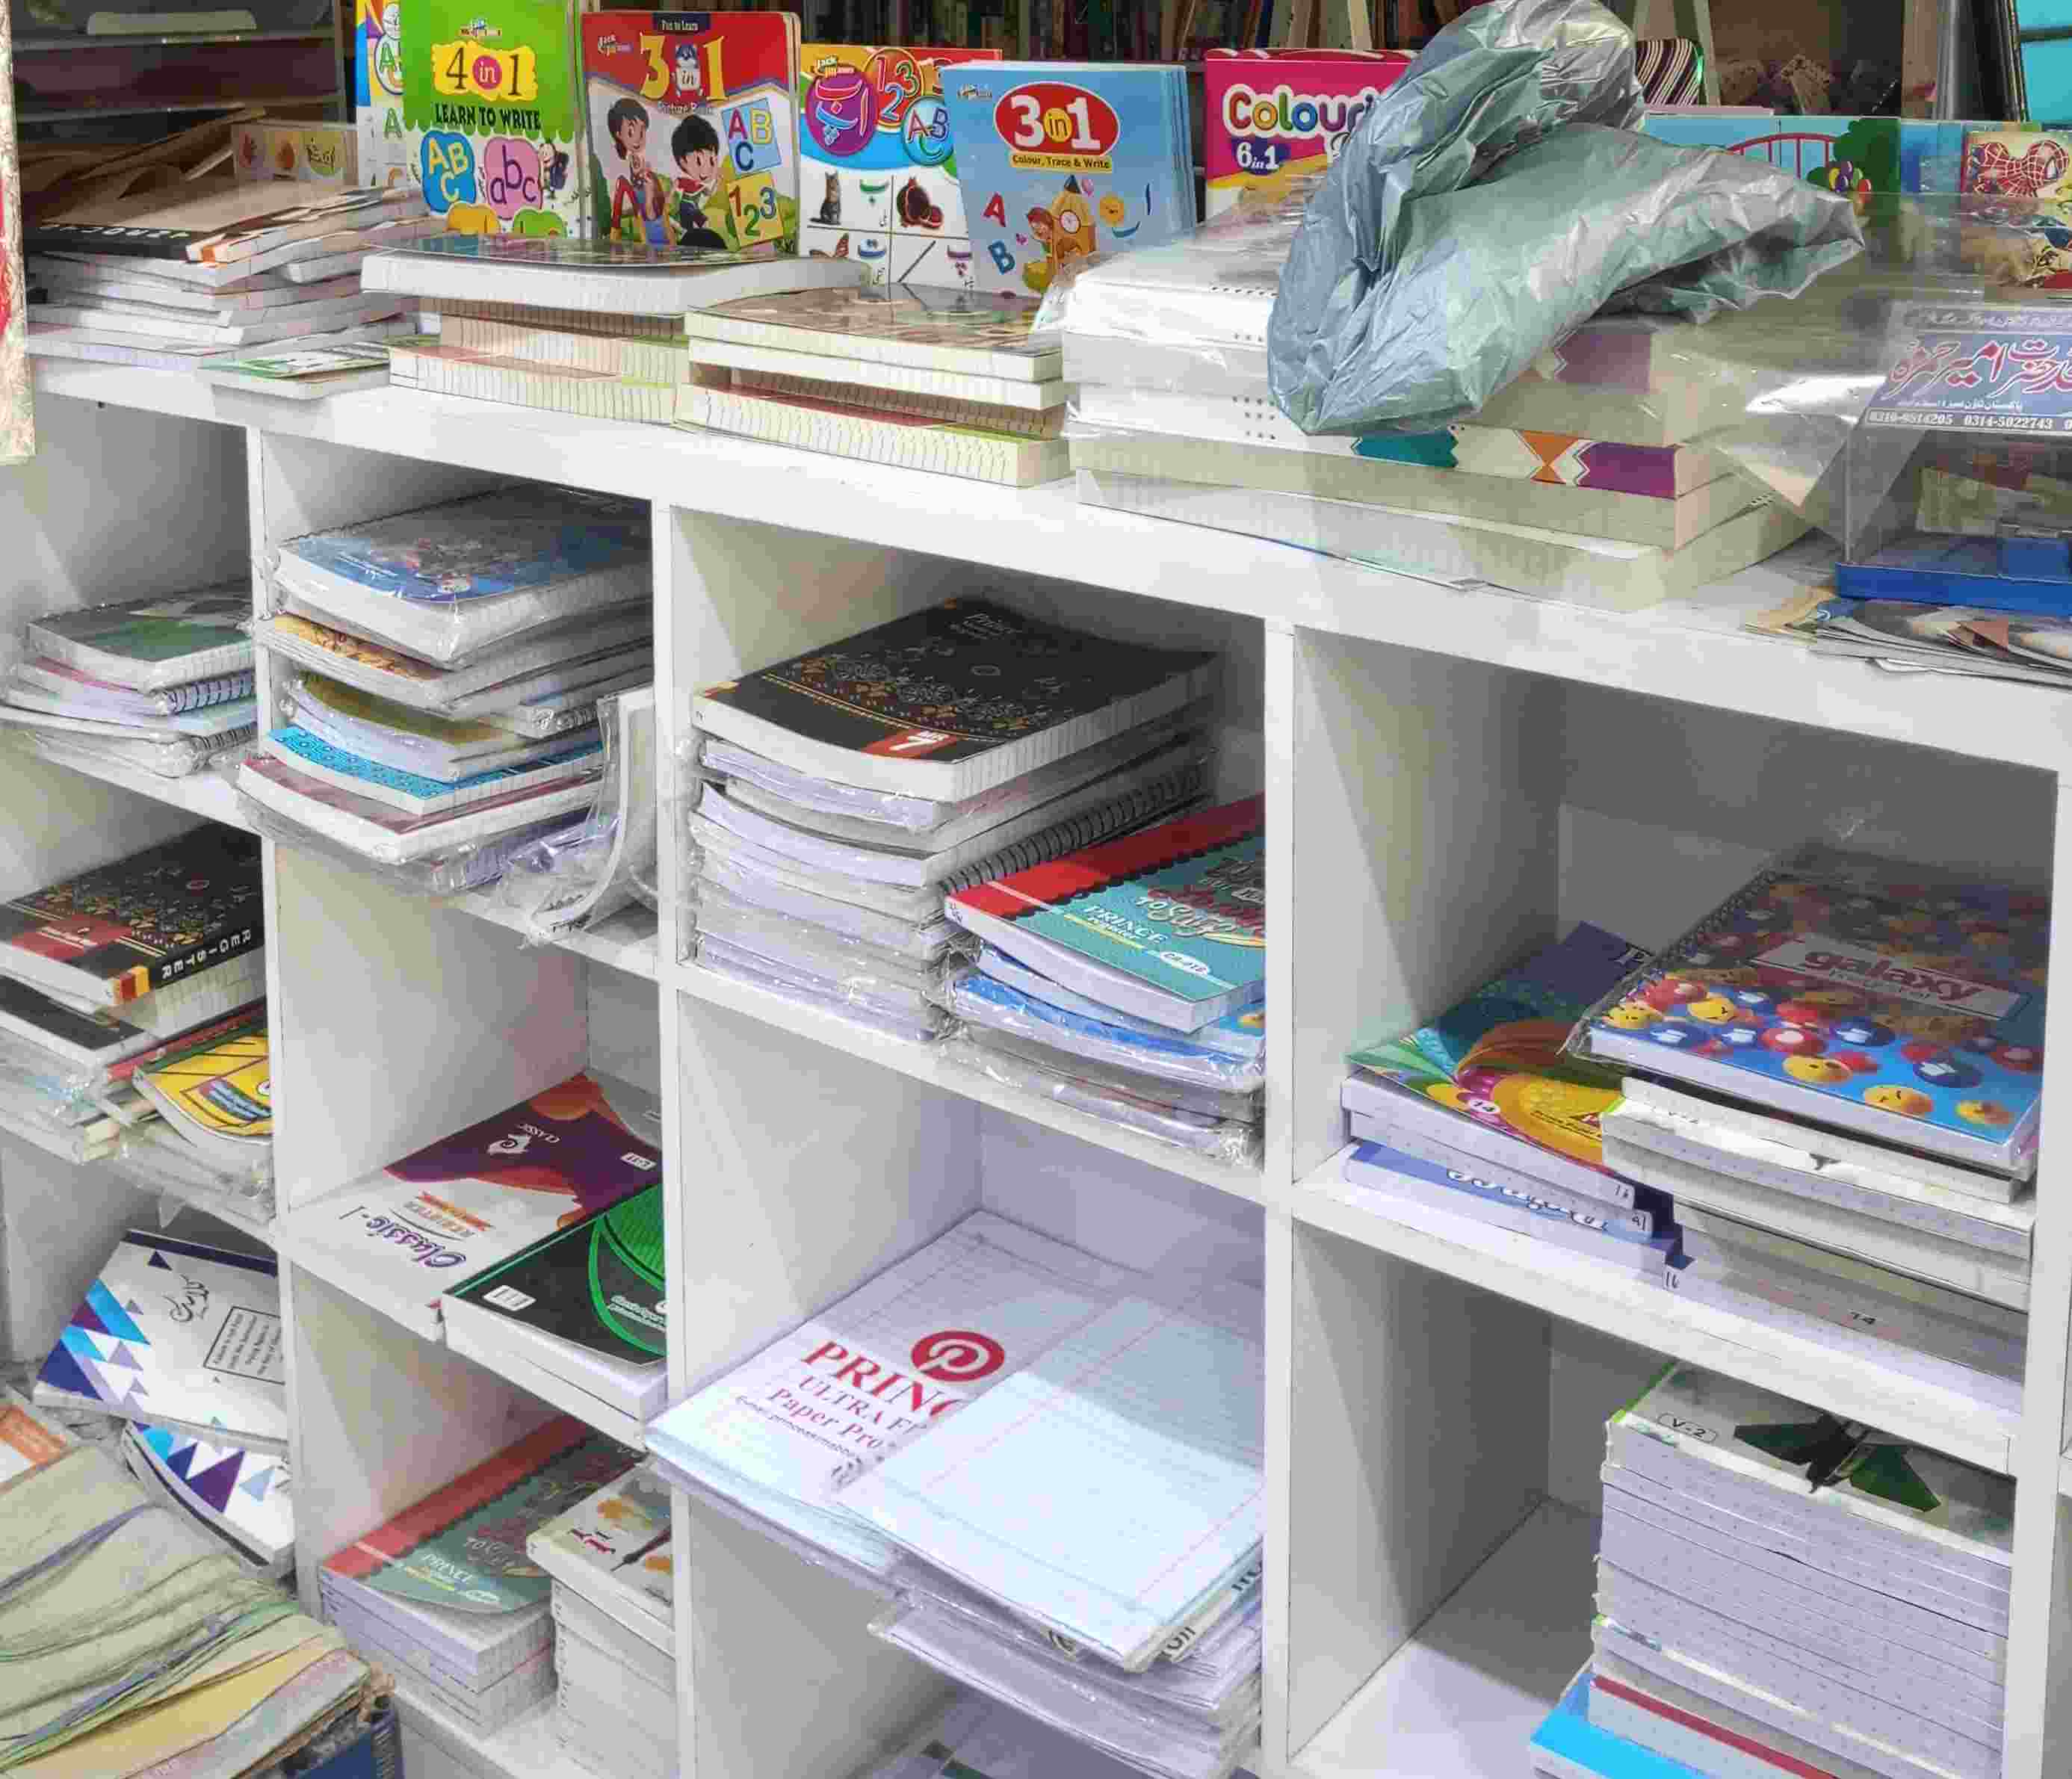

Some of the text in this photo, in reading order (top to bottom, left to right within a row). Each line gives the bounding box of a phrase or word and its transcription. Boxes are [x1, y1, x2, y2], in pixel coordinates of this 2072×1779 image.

[445, 47, 522, 96] 4 in 1
[640, 33, 670, 100] 3
[703, 35, 729, 101] 1
[435, 102, 542, 130] LEARN TO WRITE
[1010, 95, 1101, 149] 3 in 1
[1237, 142, 1252, 168] 6
[1265, 144, 1280, 170] 1
[981, 191, 1007, 228] A
[987, 239, 1016, 276] B
[1083, 905, 1169, 945] PRINCE
[161, 928, 253, 980] REGISTER
[1803, 951, 1984, 1001] galaxy
[768, 1387, 841, 1428] Paper
[799, 1374, 885, 1424] ULTRA
[1672, 1417, 1706, 1438] V-2
